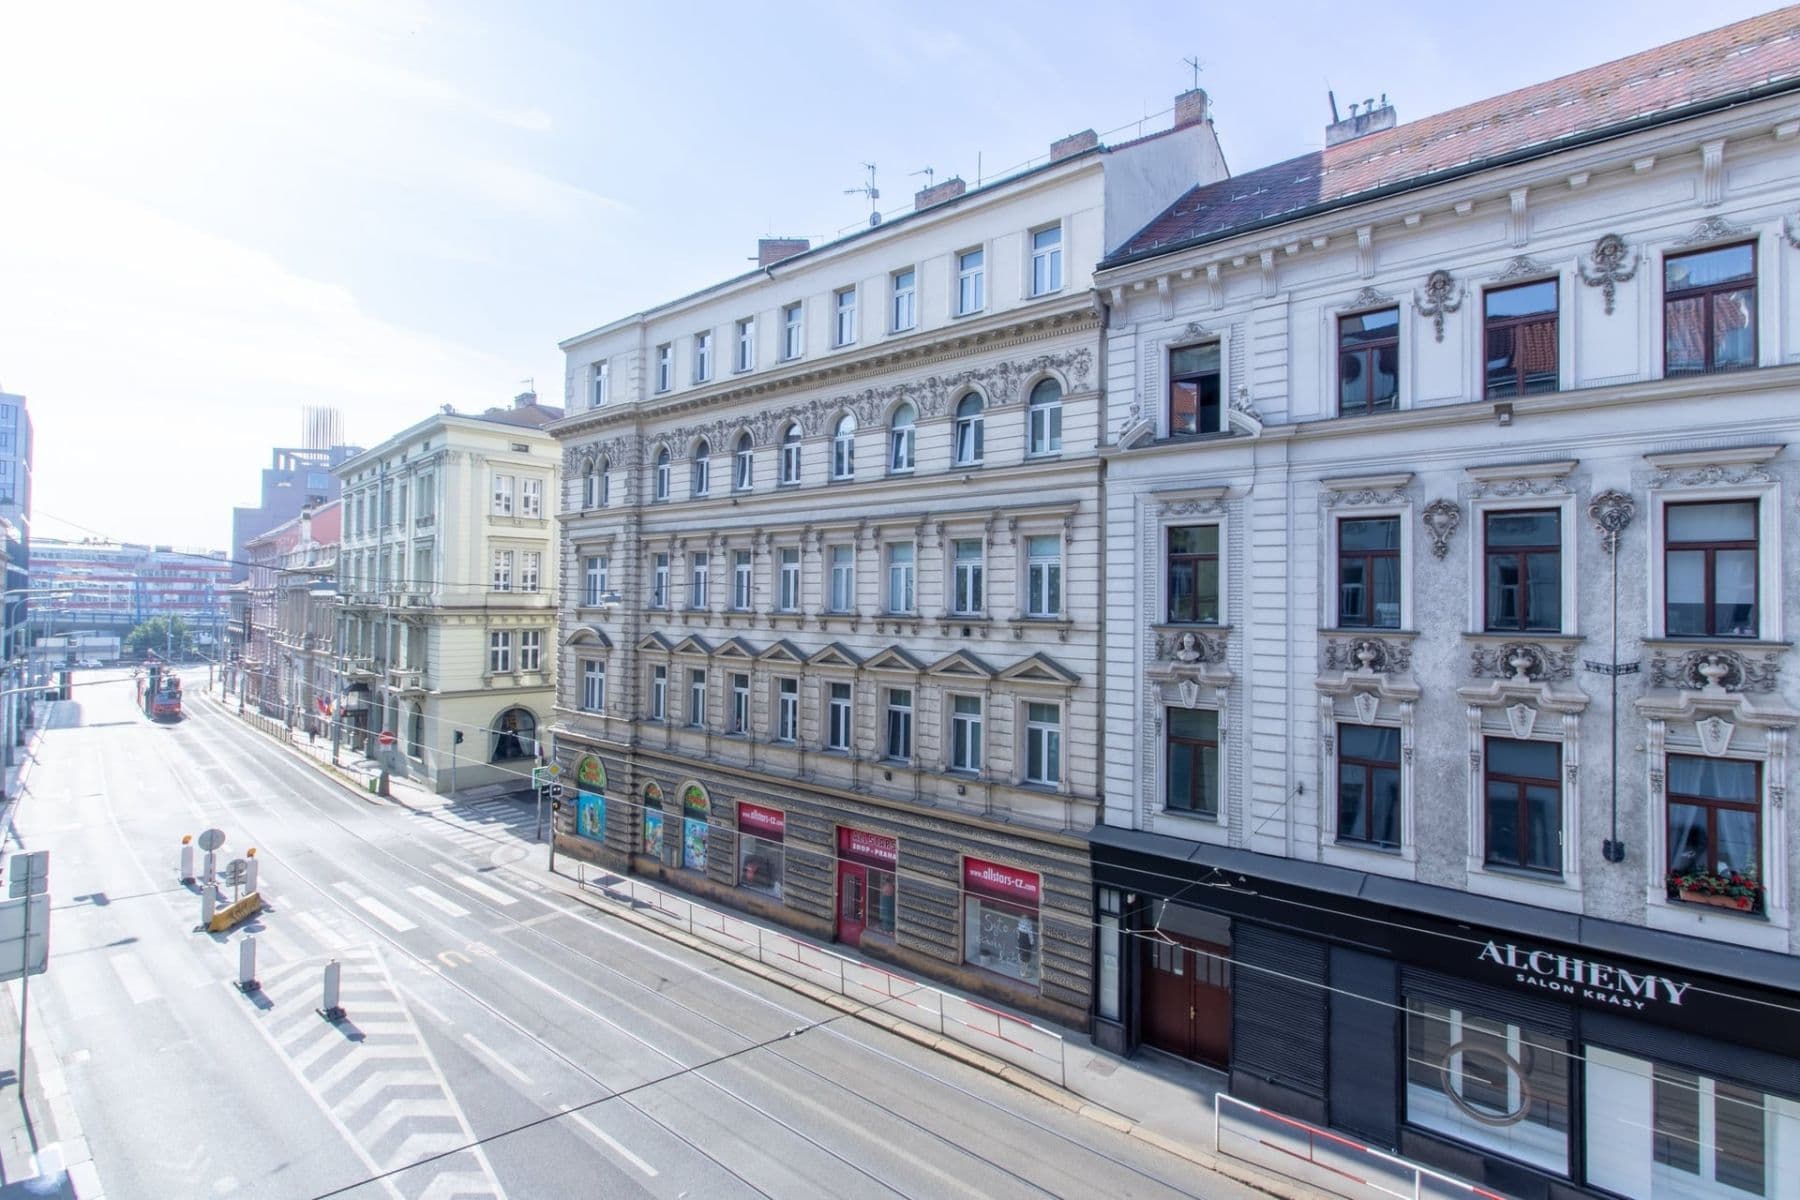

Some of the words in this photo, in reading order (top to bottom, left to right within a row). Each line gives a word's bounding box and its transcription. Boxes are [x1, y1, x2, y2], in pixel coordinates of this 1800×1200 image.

[969, 868, 1036, 892] www.allstars-cz.com
[1477, 939, 1693, 1006] ALCHEMY
[1516, 973, 1575, 995] SALON
[1583, 988, 1646, 1011] KRÁSY
